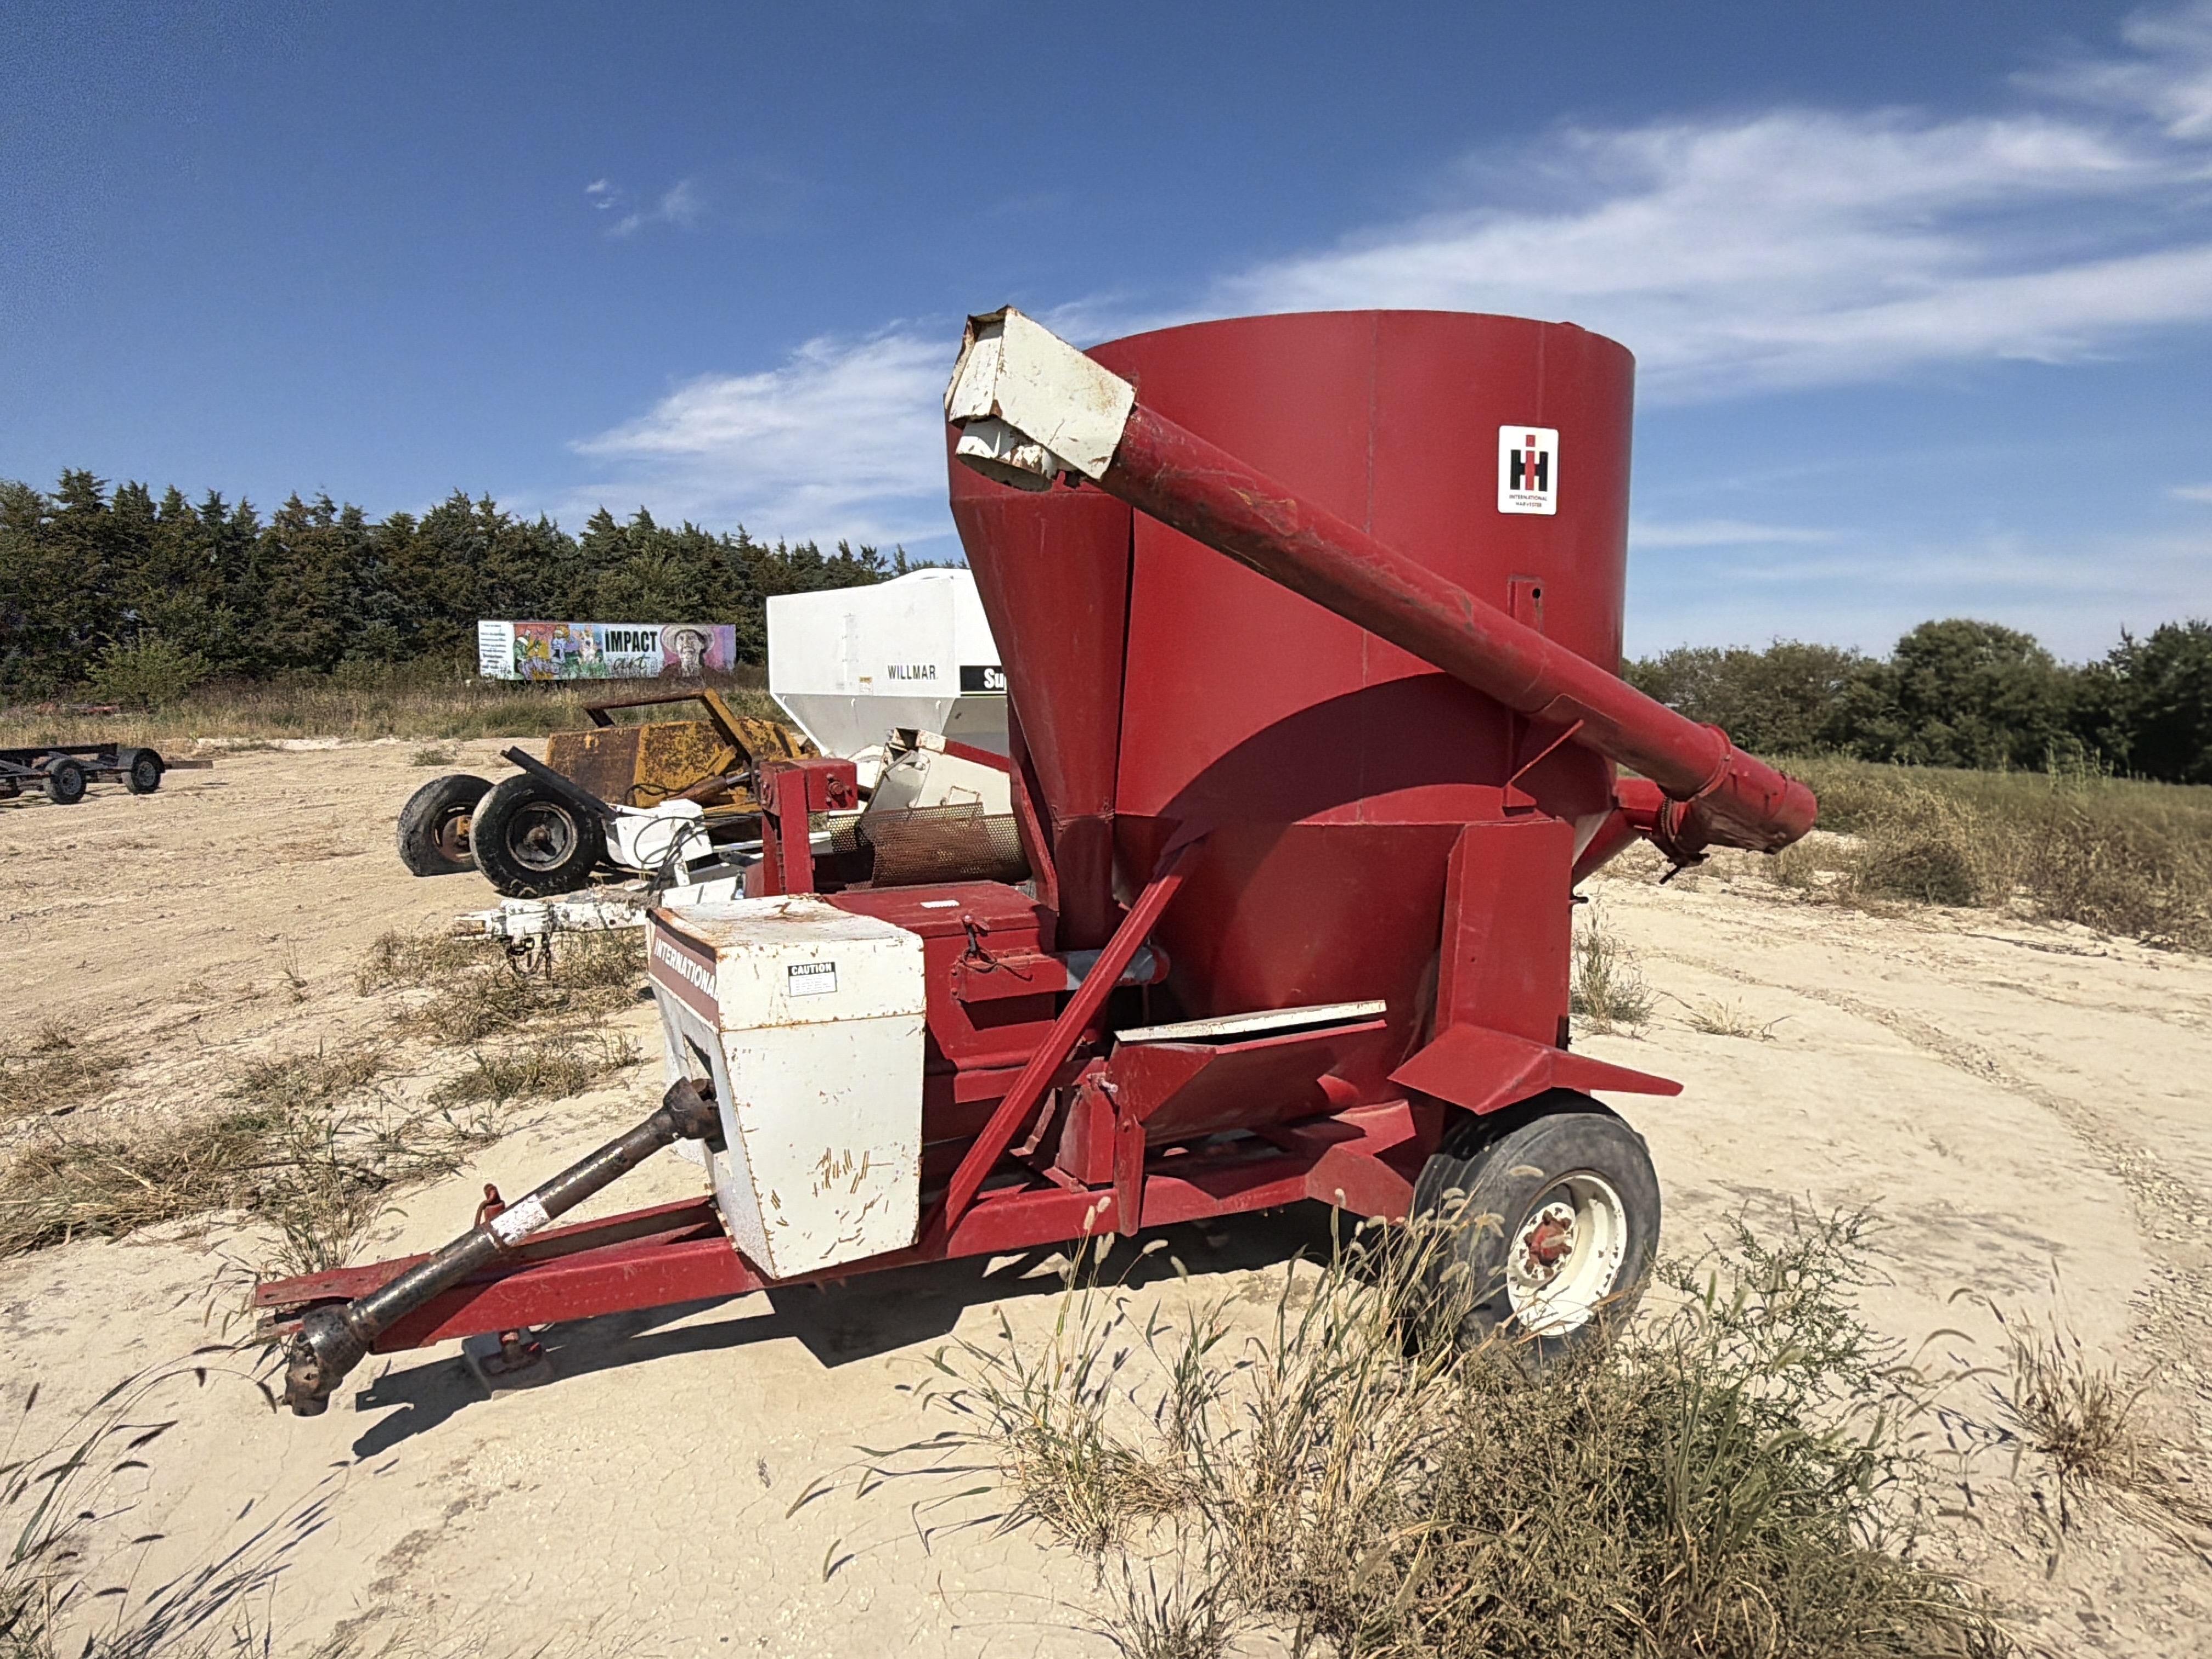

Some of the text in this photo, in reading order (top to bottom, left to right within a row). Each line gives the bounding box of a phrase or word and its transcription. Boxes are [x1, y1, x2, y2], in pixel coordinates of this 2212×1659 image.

[605, 629, 657, 652] IMPACT
[888, 665, 936, 680] WILLMAR
[791, 963, 832, 975] CAUTION
